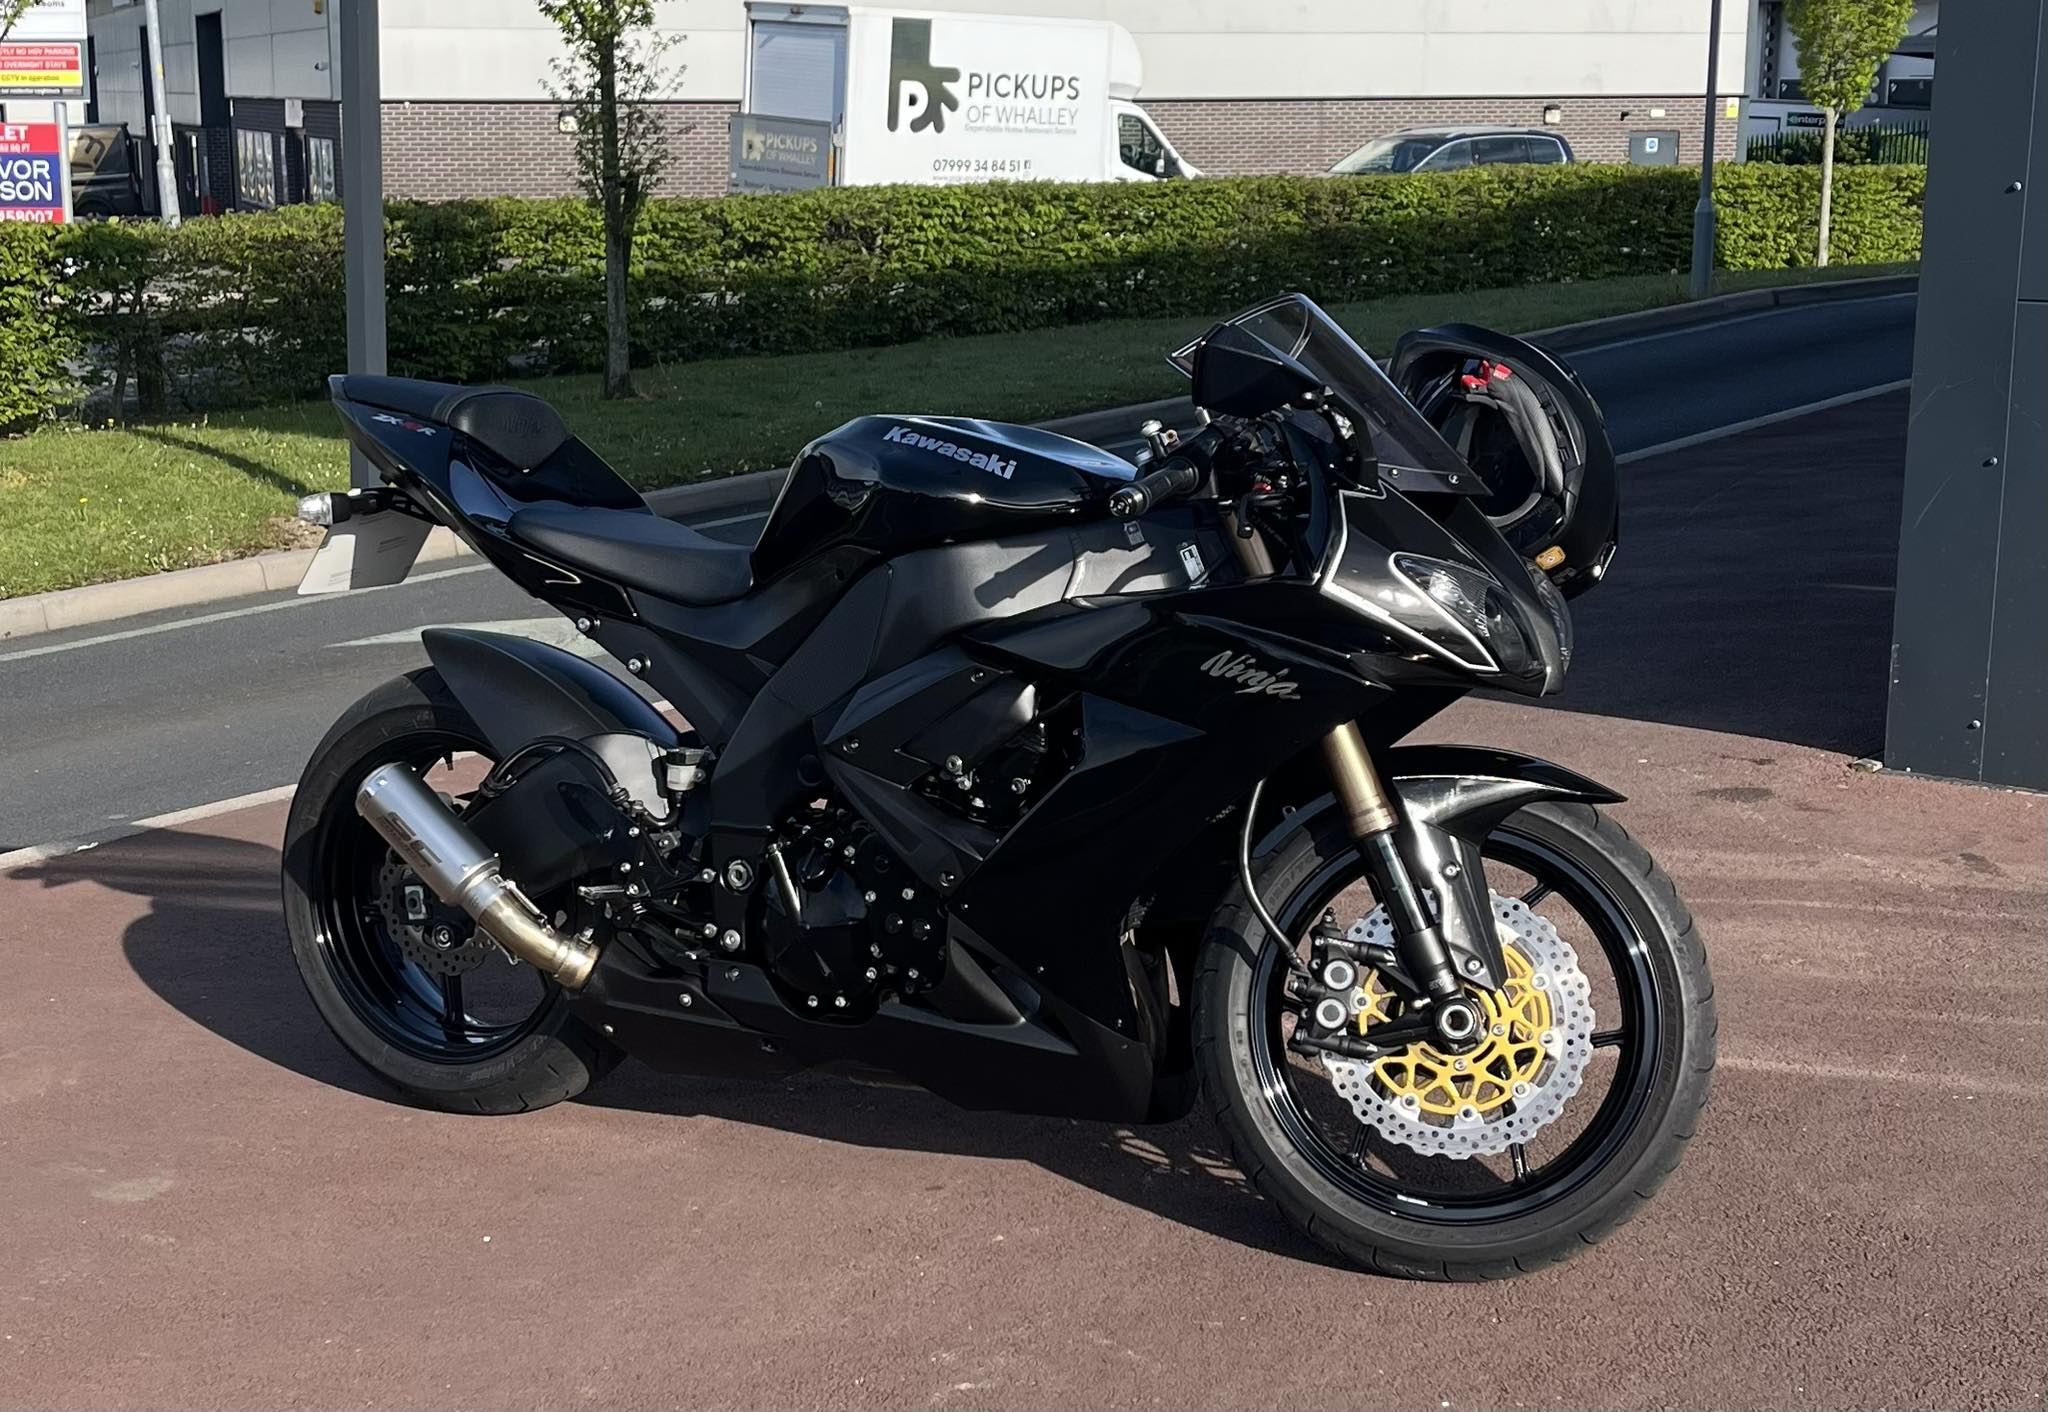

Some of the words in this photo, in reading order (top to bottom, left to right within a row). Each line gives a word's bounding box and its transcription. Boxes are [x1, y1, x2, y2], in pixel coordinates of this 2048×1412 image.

[968, 72, 1080, 100] PICKUPS
[967, 105, 991, 124] OF
[995, 106, 1079, 125] WHALLEY
[766, 133, 818, 153] PICKUPS
[933, 159, 971, 172] 07999
[974, 160, 988, 172] 34
[991, 160, 1005, 172] 84
[1009, 160, 1020, 172] 51
[0, 180, 53, 201] SON
[882, 426, 1018, 480] Kawasaki
[1200, 650, 1301, 700] Ninja
